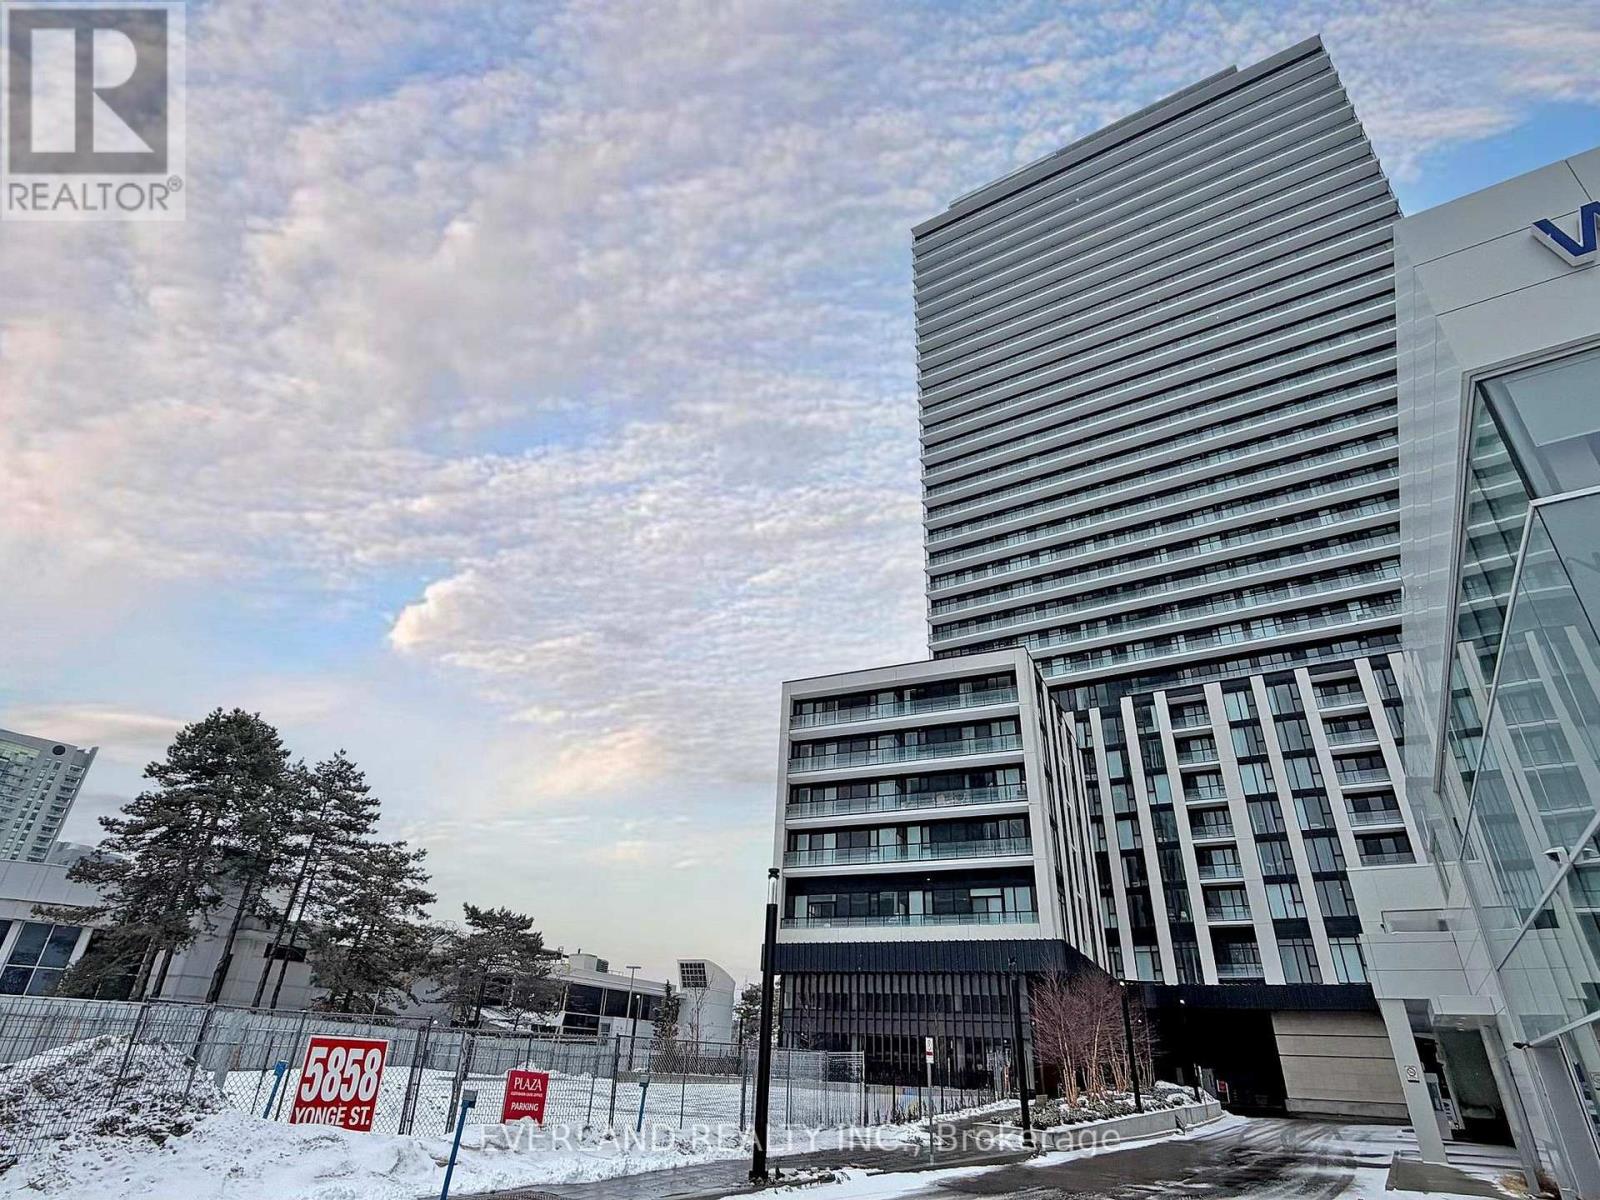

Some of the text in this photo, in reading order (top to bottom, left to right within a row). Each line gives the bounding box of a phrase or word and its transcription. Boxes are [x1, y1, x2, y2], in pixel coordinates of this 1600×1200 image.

[301, 1046, 381, 1102] 5858
[514, 1077, 542, 1091] PLAZA
[511, 1102, 539, 1111] PARKING
[295, 1106, 370, 1125] YONGE ST.
